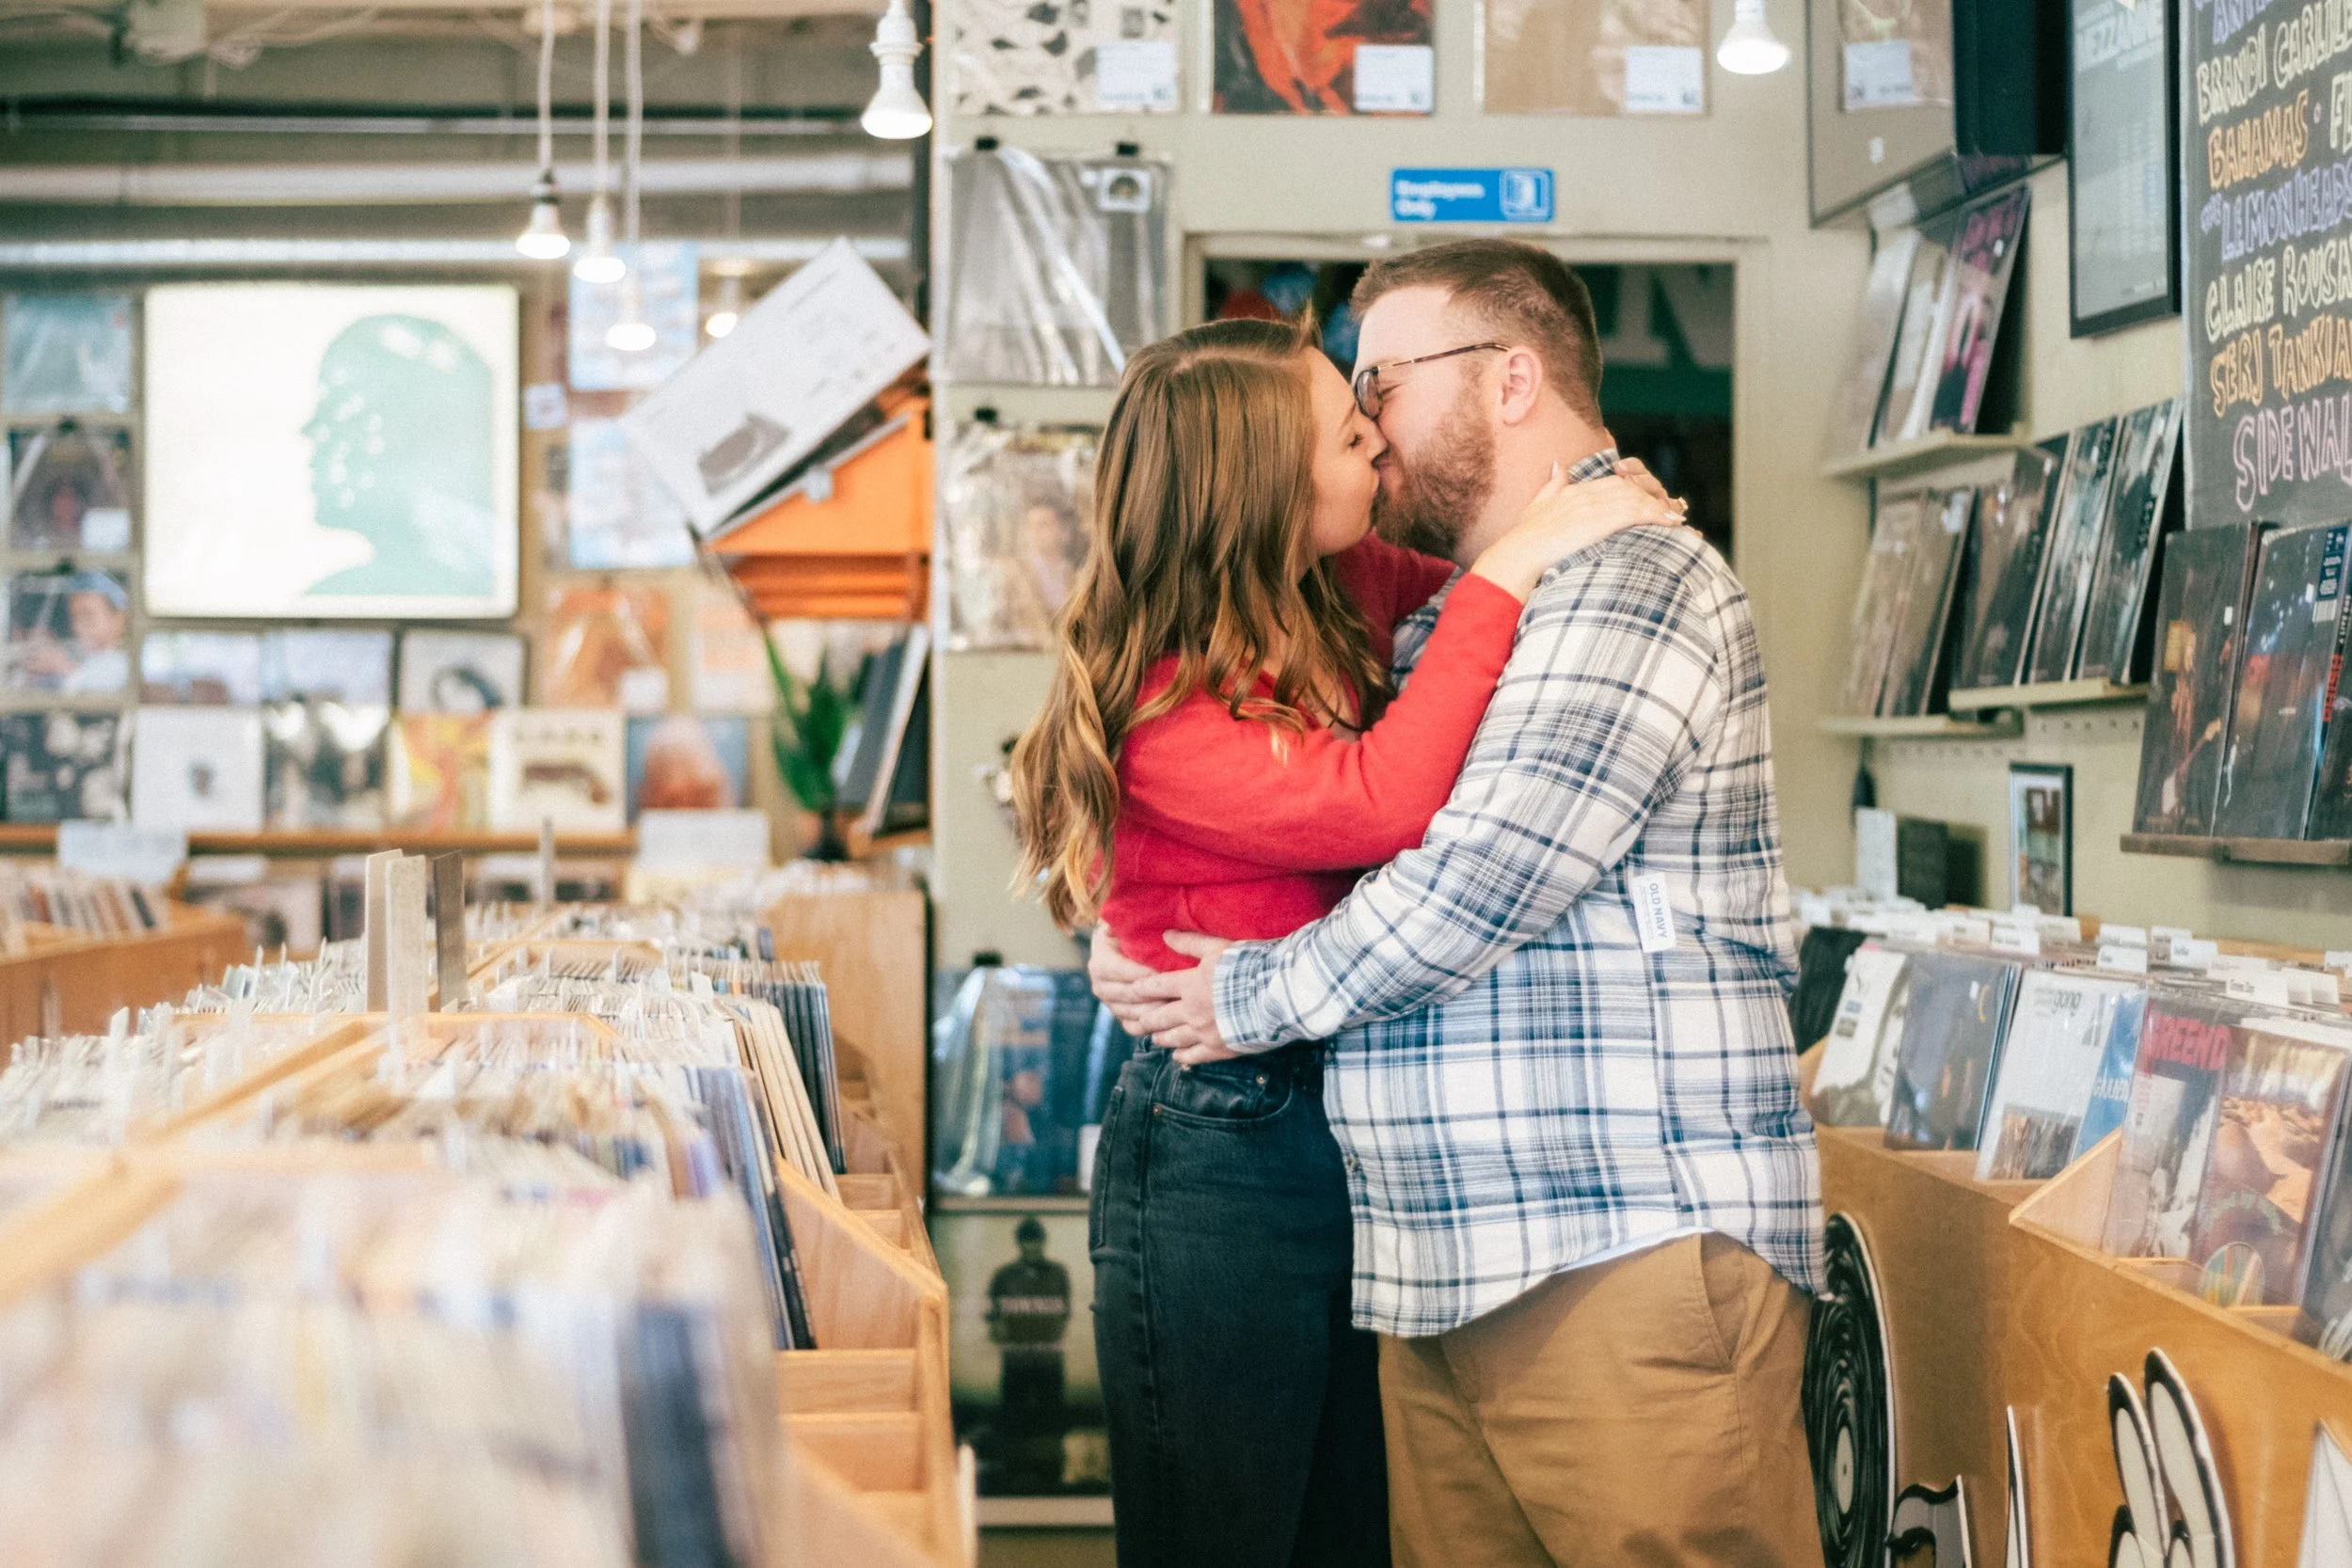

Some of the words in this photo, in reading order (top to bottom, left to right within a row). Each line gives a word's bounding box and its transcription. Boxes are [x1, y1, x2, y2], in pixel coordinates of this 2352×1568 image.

[2196, 23, 2267, 127] BRANDI
[2208, 87, 2309, 189] BAHAMAS
[2205, 256, 2276, 343] CLAIRE
[2283, 235, 2352, 318] ROUSA
[2211, 329, 2264, 419] SERJ
[2268, 312, 2352, 402] TANKIA
[1649, 882, 1661, 905] OLD
[1654, 908, 1668, 938] NAVY
